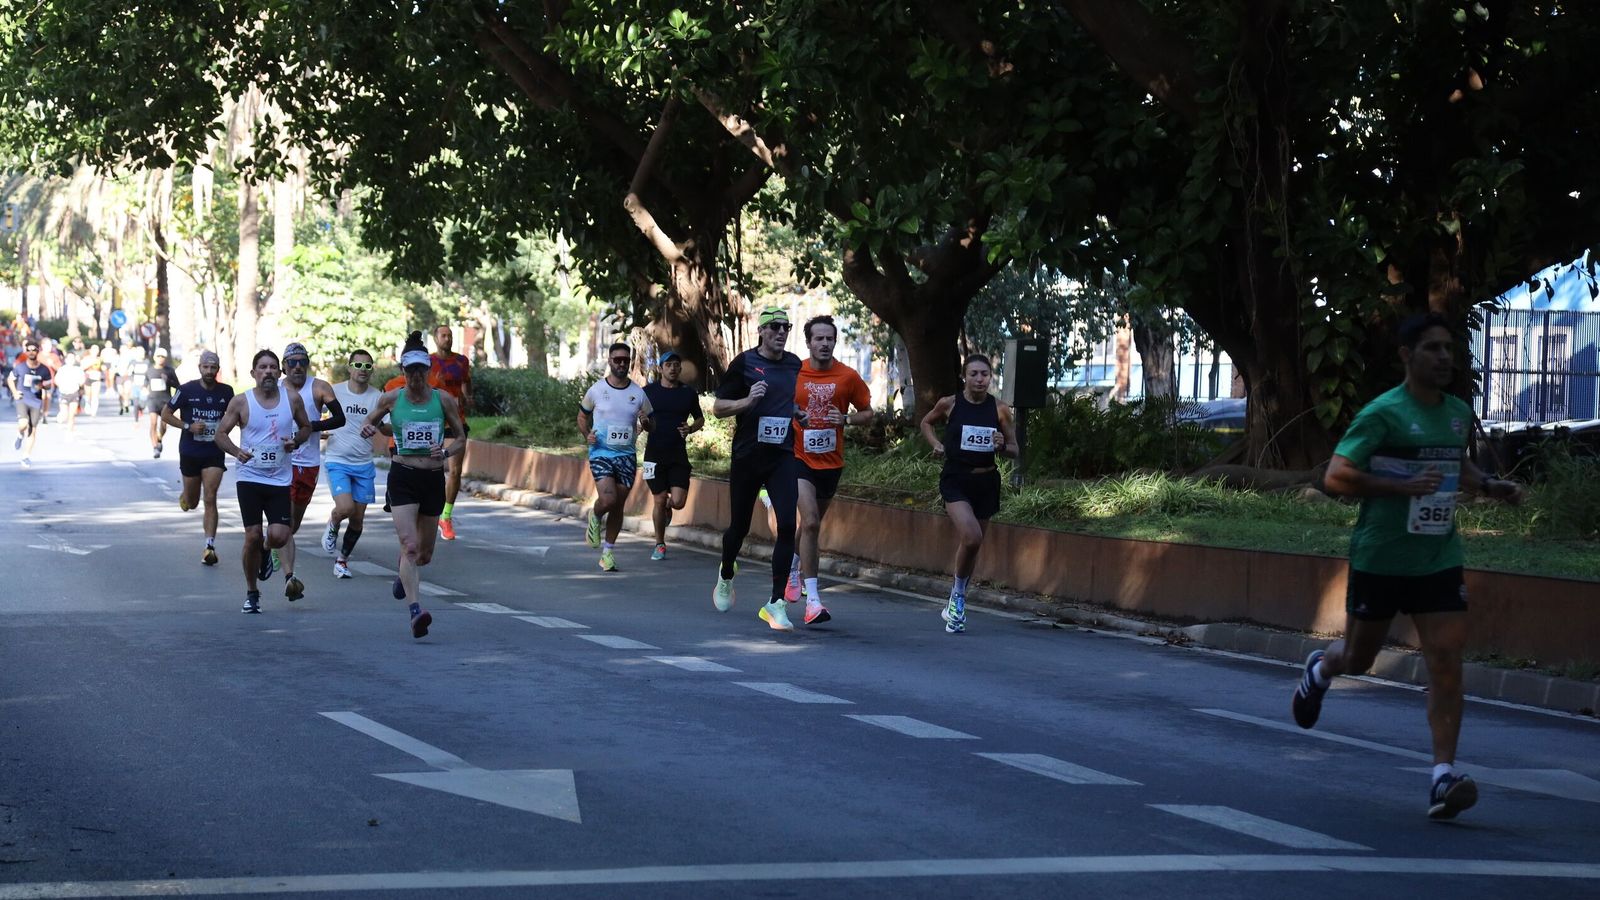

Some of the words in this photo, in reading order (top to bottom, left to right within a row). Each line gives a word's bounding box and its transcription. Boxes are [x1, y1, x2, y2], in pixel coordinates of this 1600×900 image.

[346, 404, 368, 415] nike
[407, 431, 433, 441] 828
[611, 432, 629, 440] 976
[764, 426, 786, 436] 510
[809, 437, 831, 447] 321
[967, 435, 991, 445] 435
[261, 452, 277, 461] 36
[1419, 507, 1451, 522] 362
